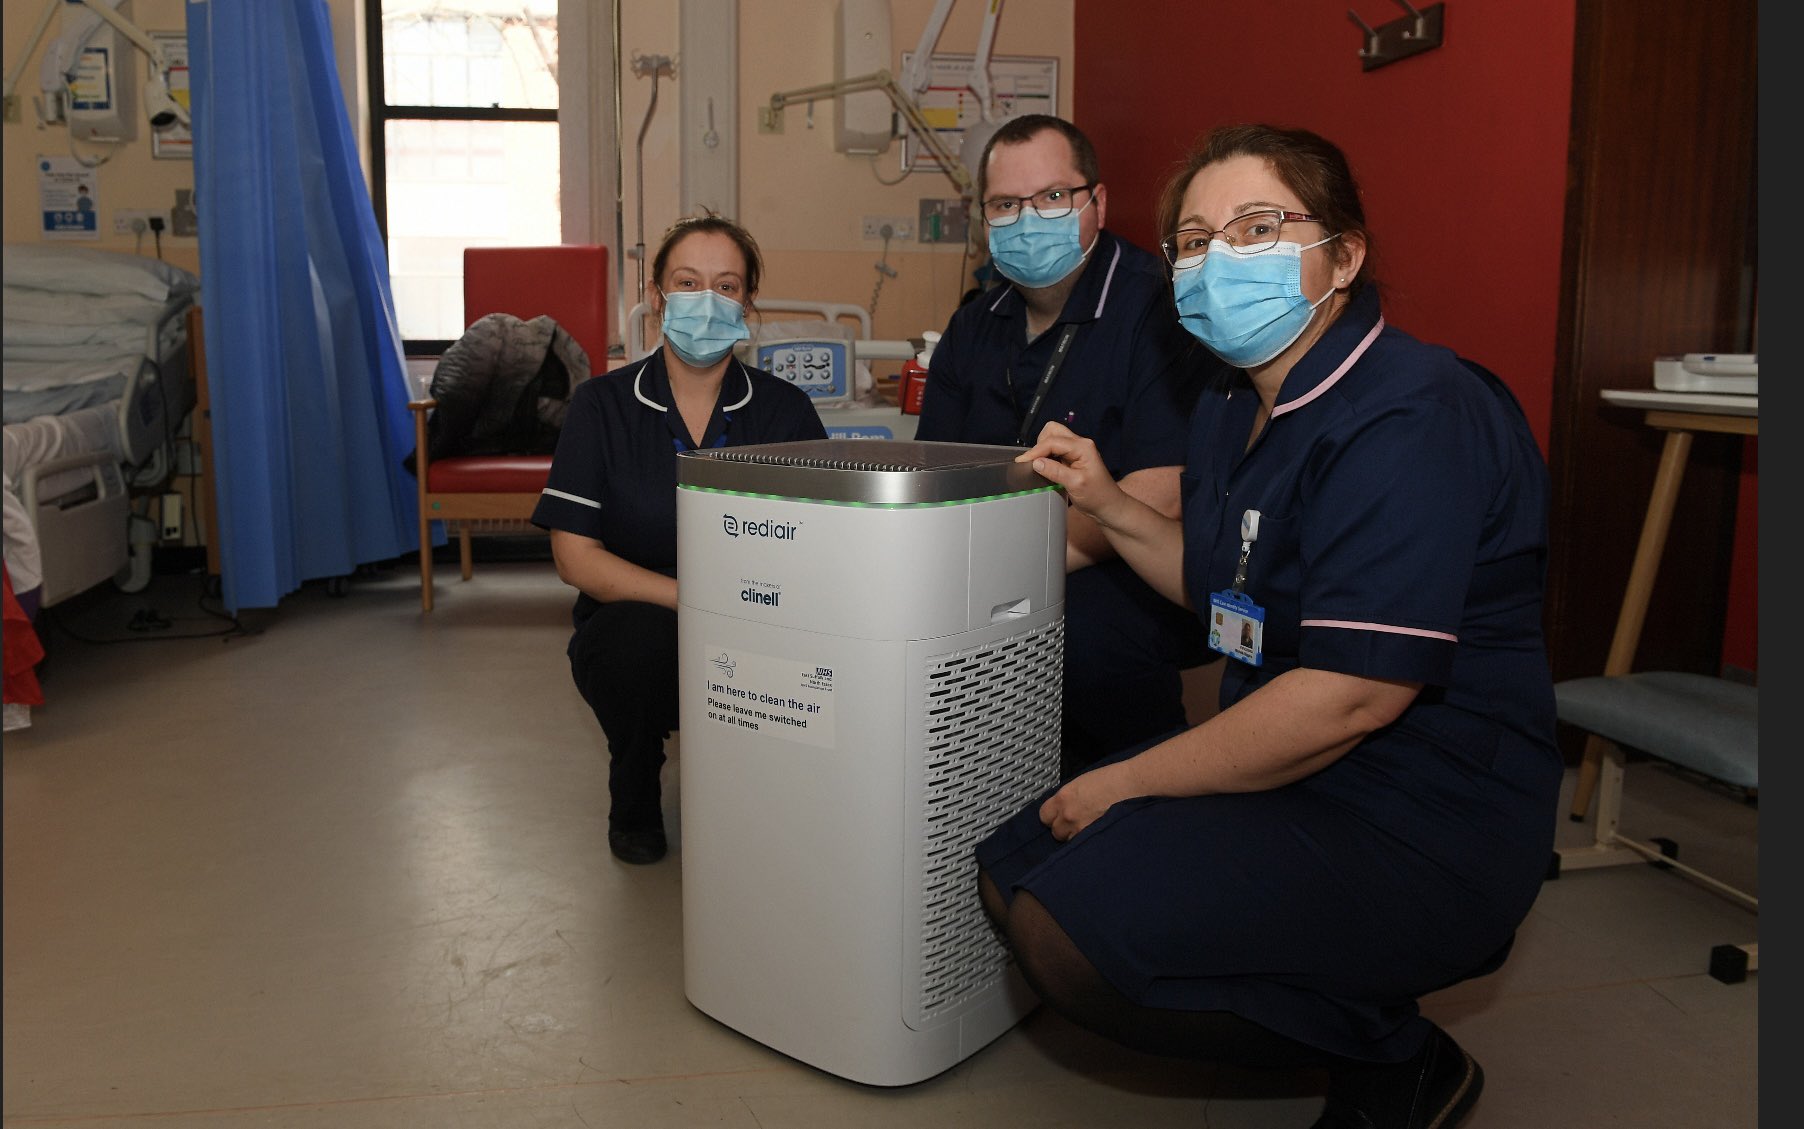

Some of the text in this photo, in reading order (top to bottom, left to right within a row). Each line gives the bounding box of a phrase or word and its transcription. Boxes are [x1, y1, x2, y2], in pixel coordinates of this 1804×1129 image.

[743, 520, 797, 540] rediair
[741, 588, 778, 606] clinell
[816, 668, 832, 677] NHS
[712, 684, 724, 693] am
[727, 685, 746, 698] here
[748, 690, 757, 701] to
[760, 693, 785, 707] clean
[788, 699, 804, 710] the
[807, 703, 820, 713] air
[707, 697, 807, 728] Please leave me switched
[708, 711, 759, 730] on at all times
